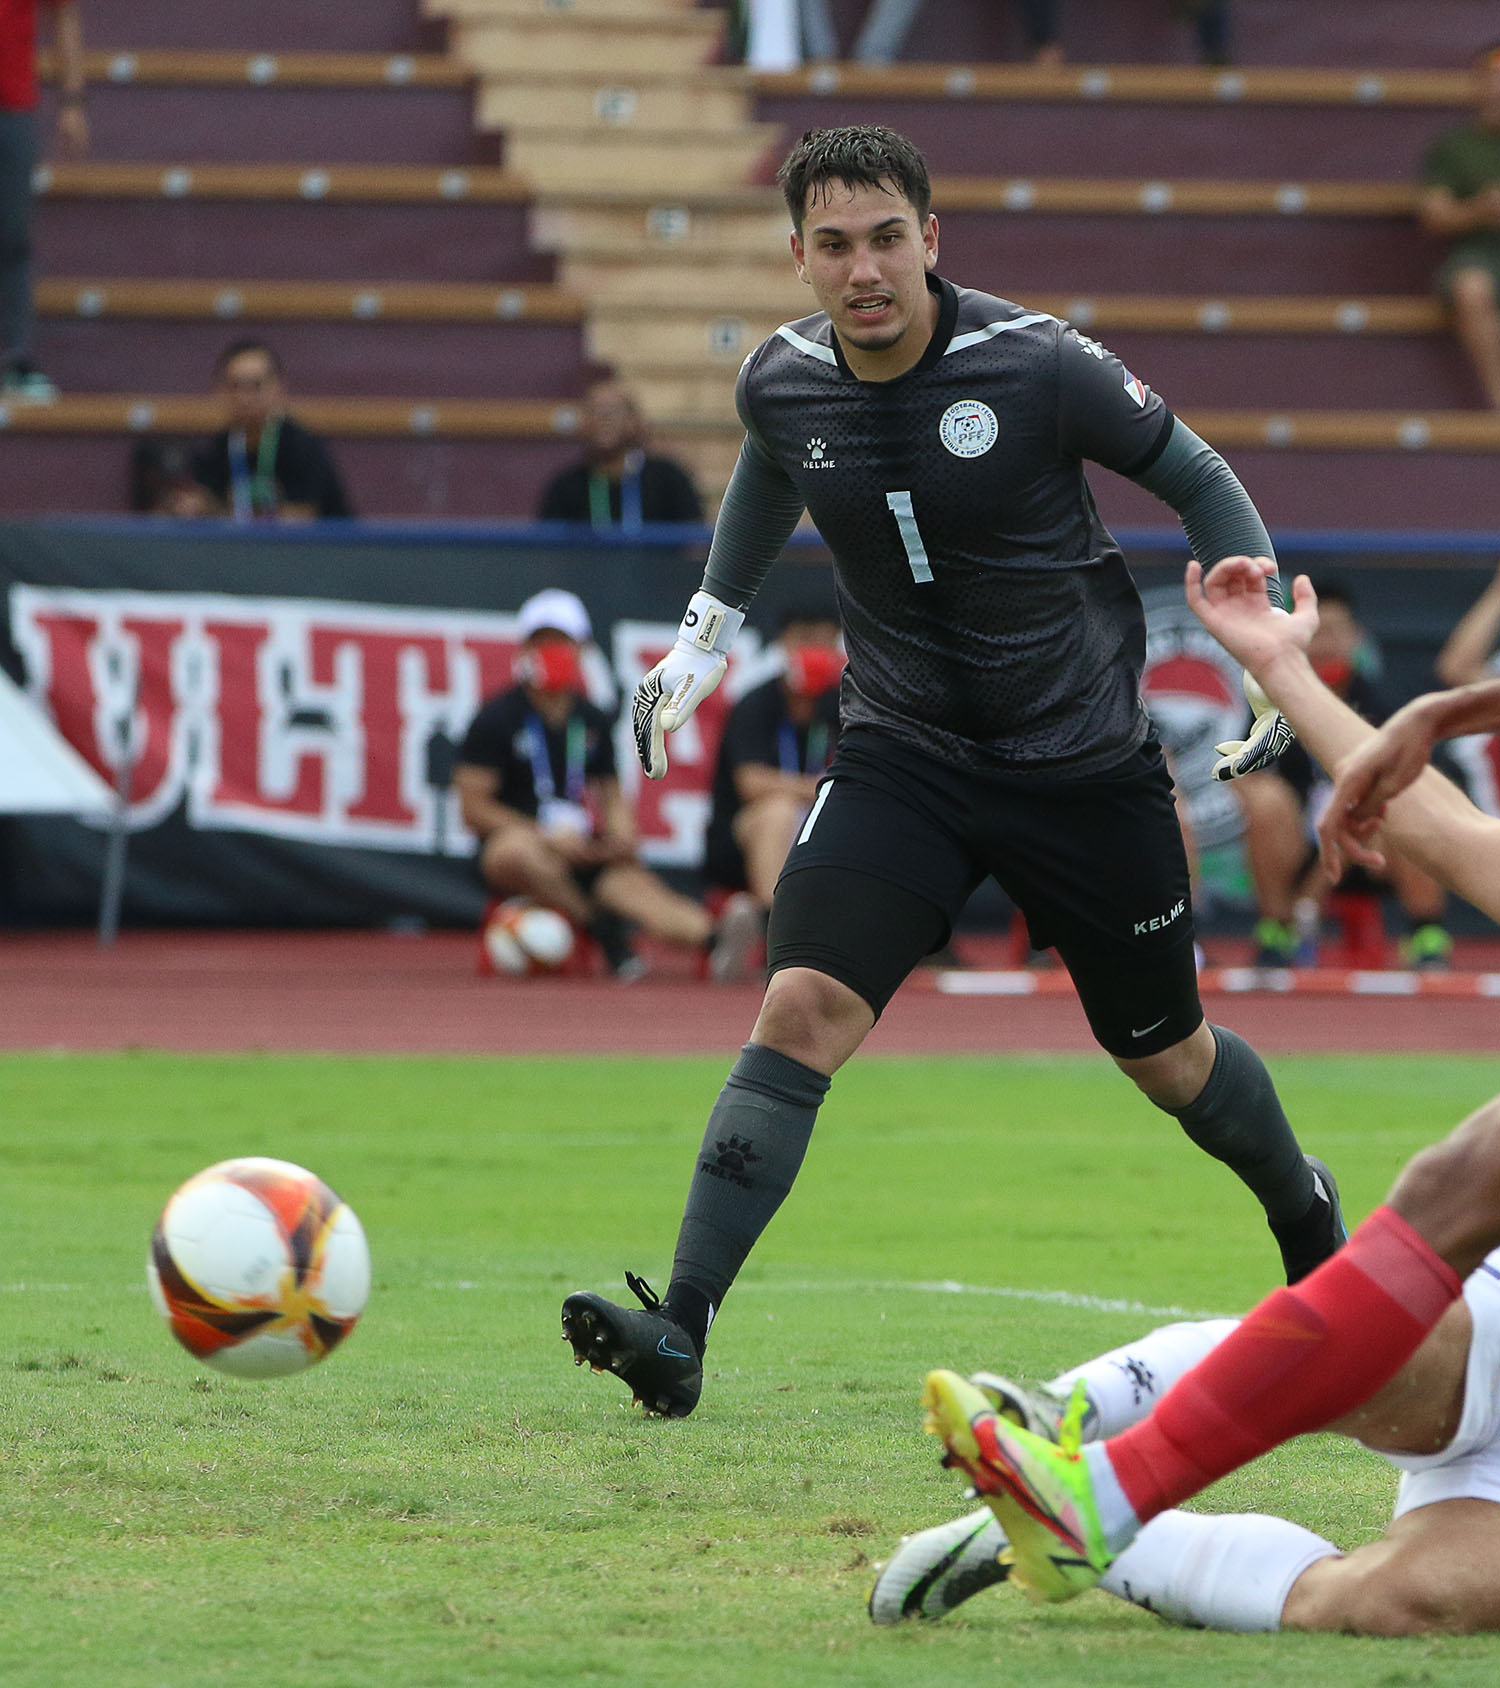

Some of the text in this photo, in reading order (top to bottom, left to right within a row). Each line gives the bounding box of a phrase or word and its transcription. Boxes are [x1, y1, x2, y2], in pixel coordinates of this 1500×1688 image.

[947, 403, 981, 417] FOOTBALL
[981, 407, 996, 446] FEDERATION
[958, 430, 985, 444] PFF
[803, 460, 836, 469] KELME
[886, 491, 934, 583] 1
[1134, 899, 1185, 935] KELME
